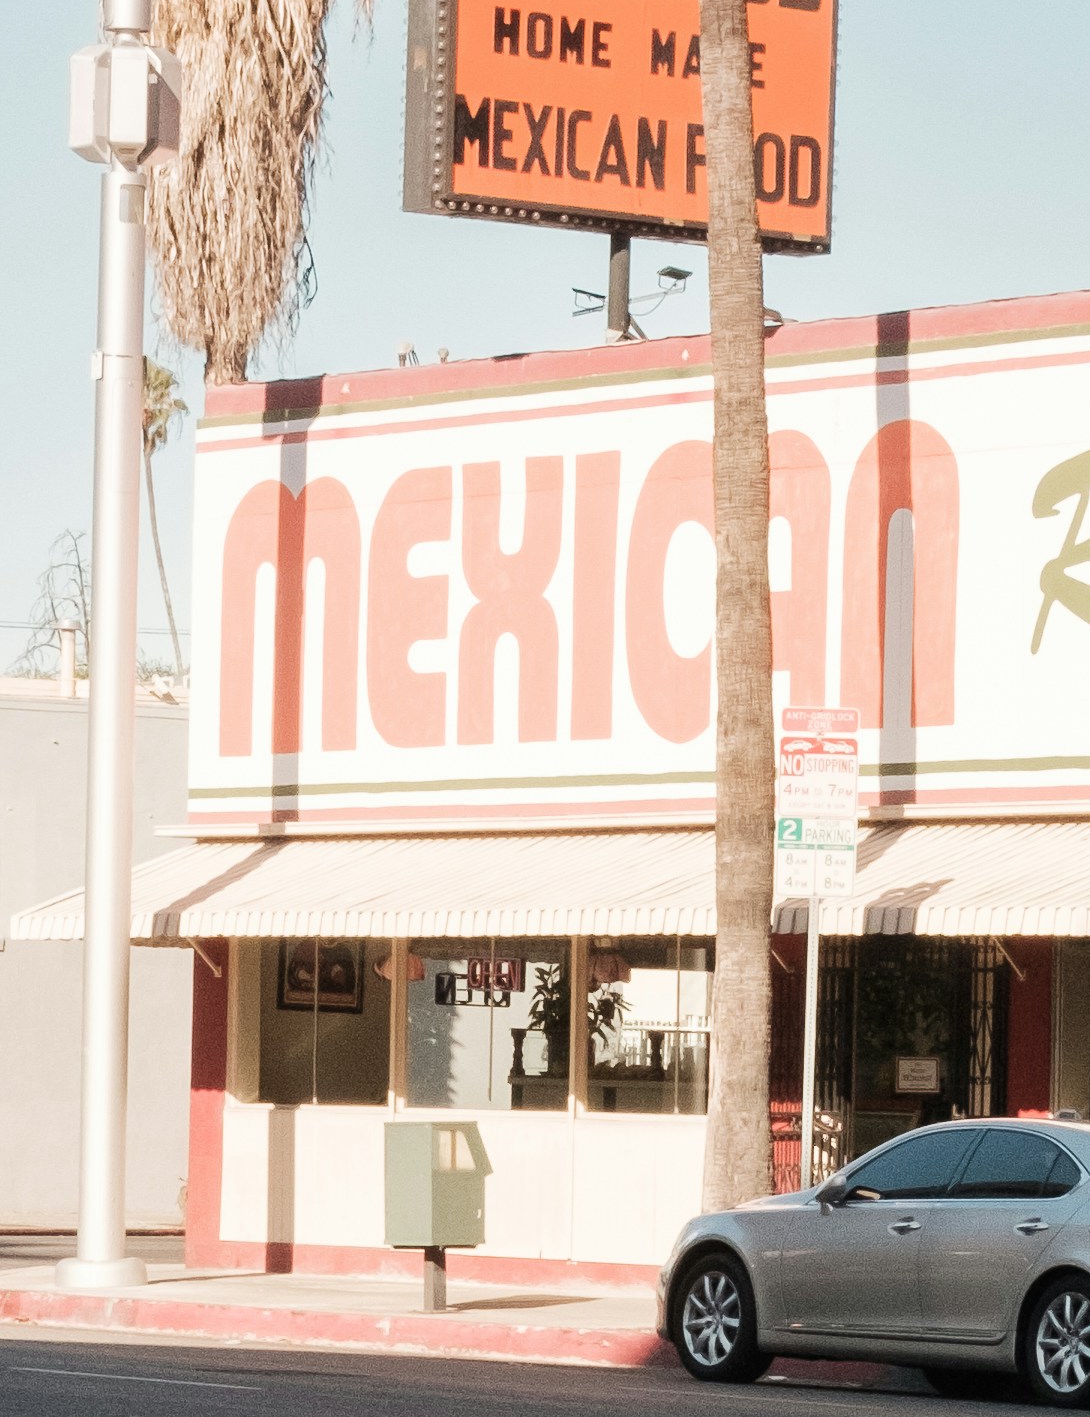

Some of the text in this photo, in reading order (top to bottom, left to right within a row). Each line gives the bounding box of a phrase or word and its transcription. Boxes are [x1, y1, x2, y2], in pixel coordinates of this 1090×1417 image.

[493, 6, 766, 89] HOME MAE
[454, 93, 821, 208] MEXICAN FOD
[218, 419, 960, 757] MEXICAN
[780, 754, 854, 775] NO STOPPING
[782, 819, 797, 840] 2
[805, 828, 852, 844] PARKING
